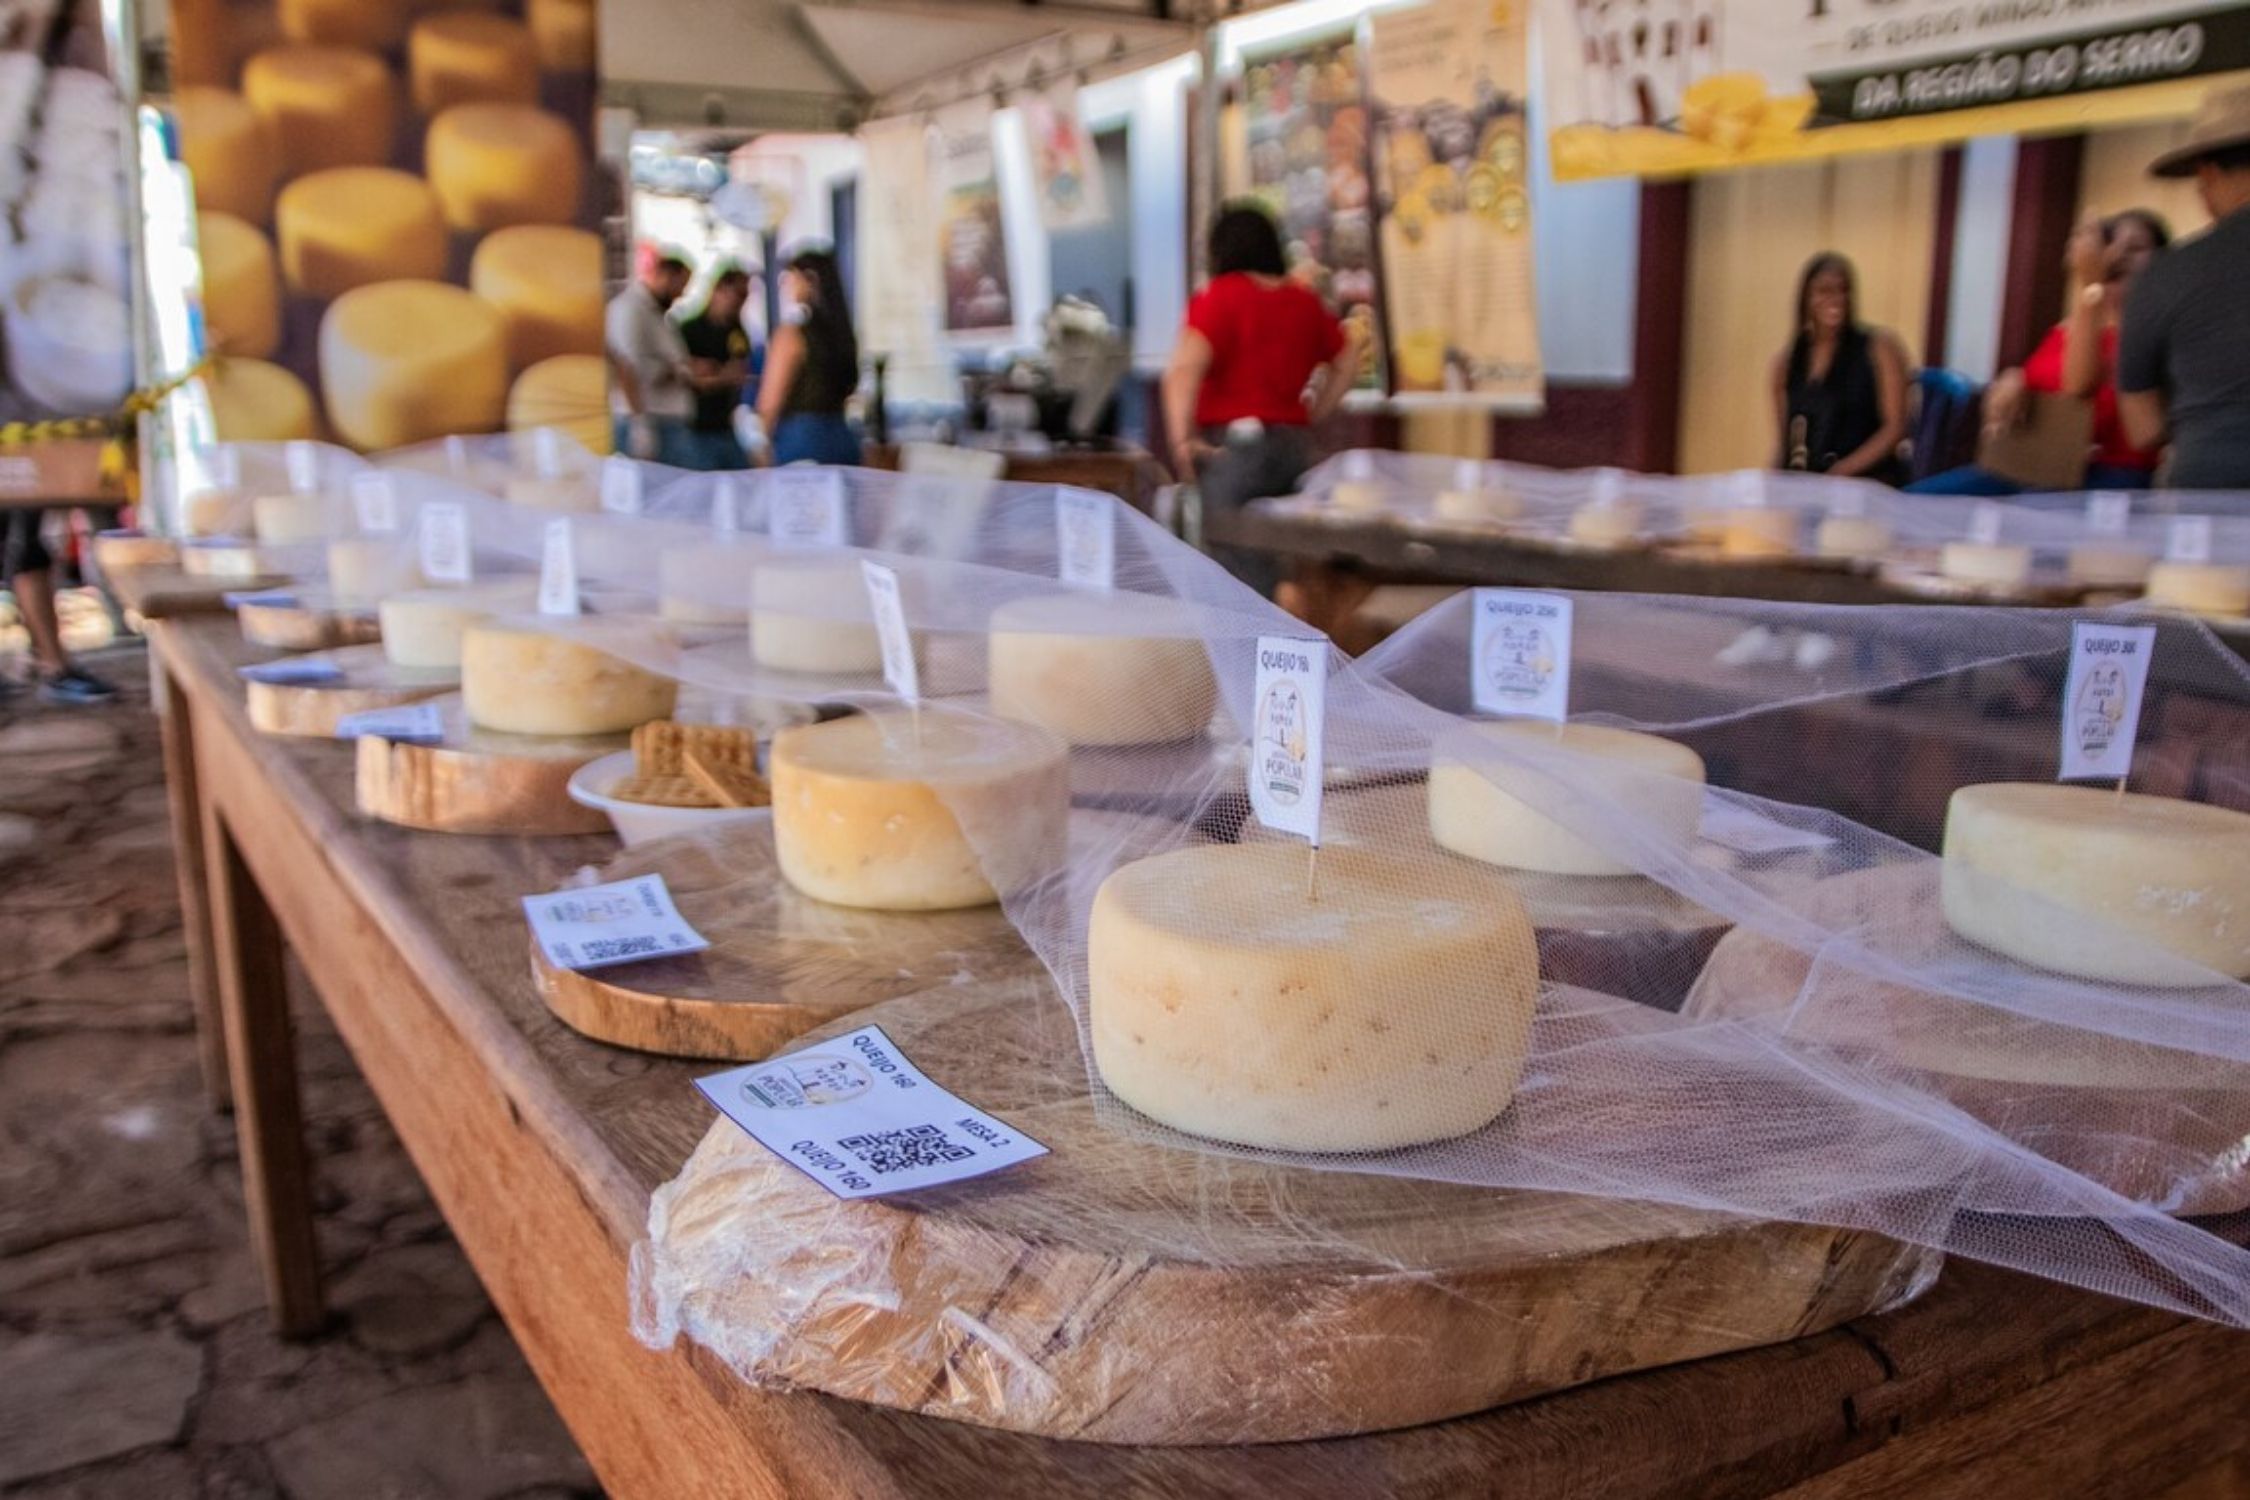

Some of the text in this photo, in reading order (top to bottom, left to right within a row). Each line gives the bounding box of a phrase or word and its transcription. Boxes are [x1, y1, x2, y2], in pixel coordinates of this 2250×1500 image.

[1853, 22, 2205, 118] DA REGIÃO DO SERRO
[1261, 650, 1296, 673] QUEIJO
[853, 1034, 898, 1074] QUEIJO
[954, 1118, 1011, 1149] MESA 2
[790, 1140, 873, 1191] QUEIJO 160
